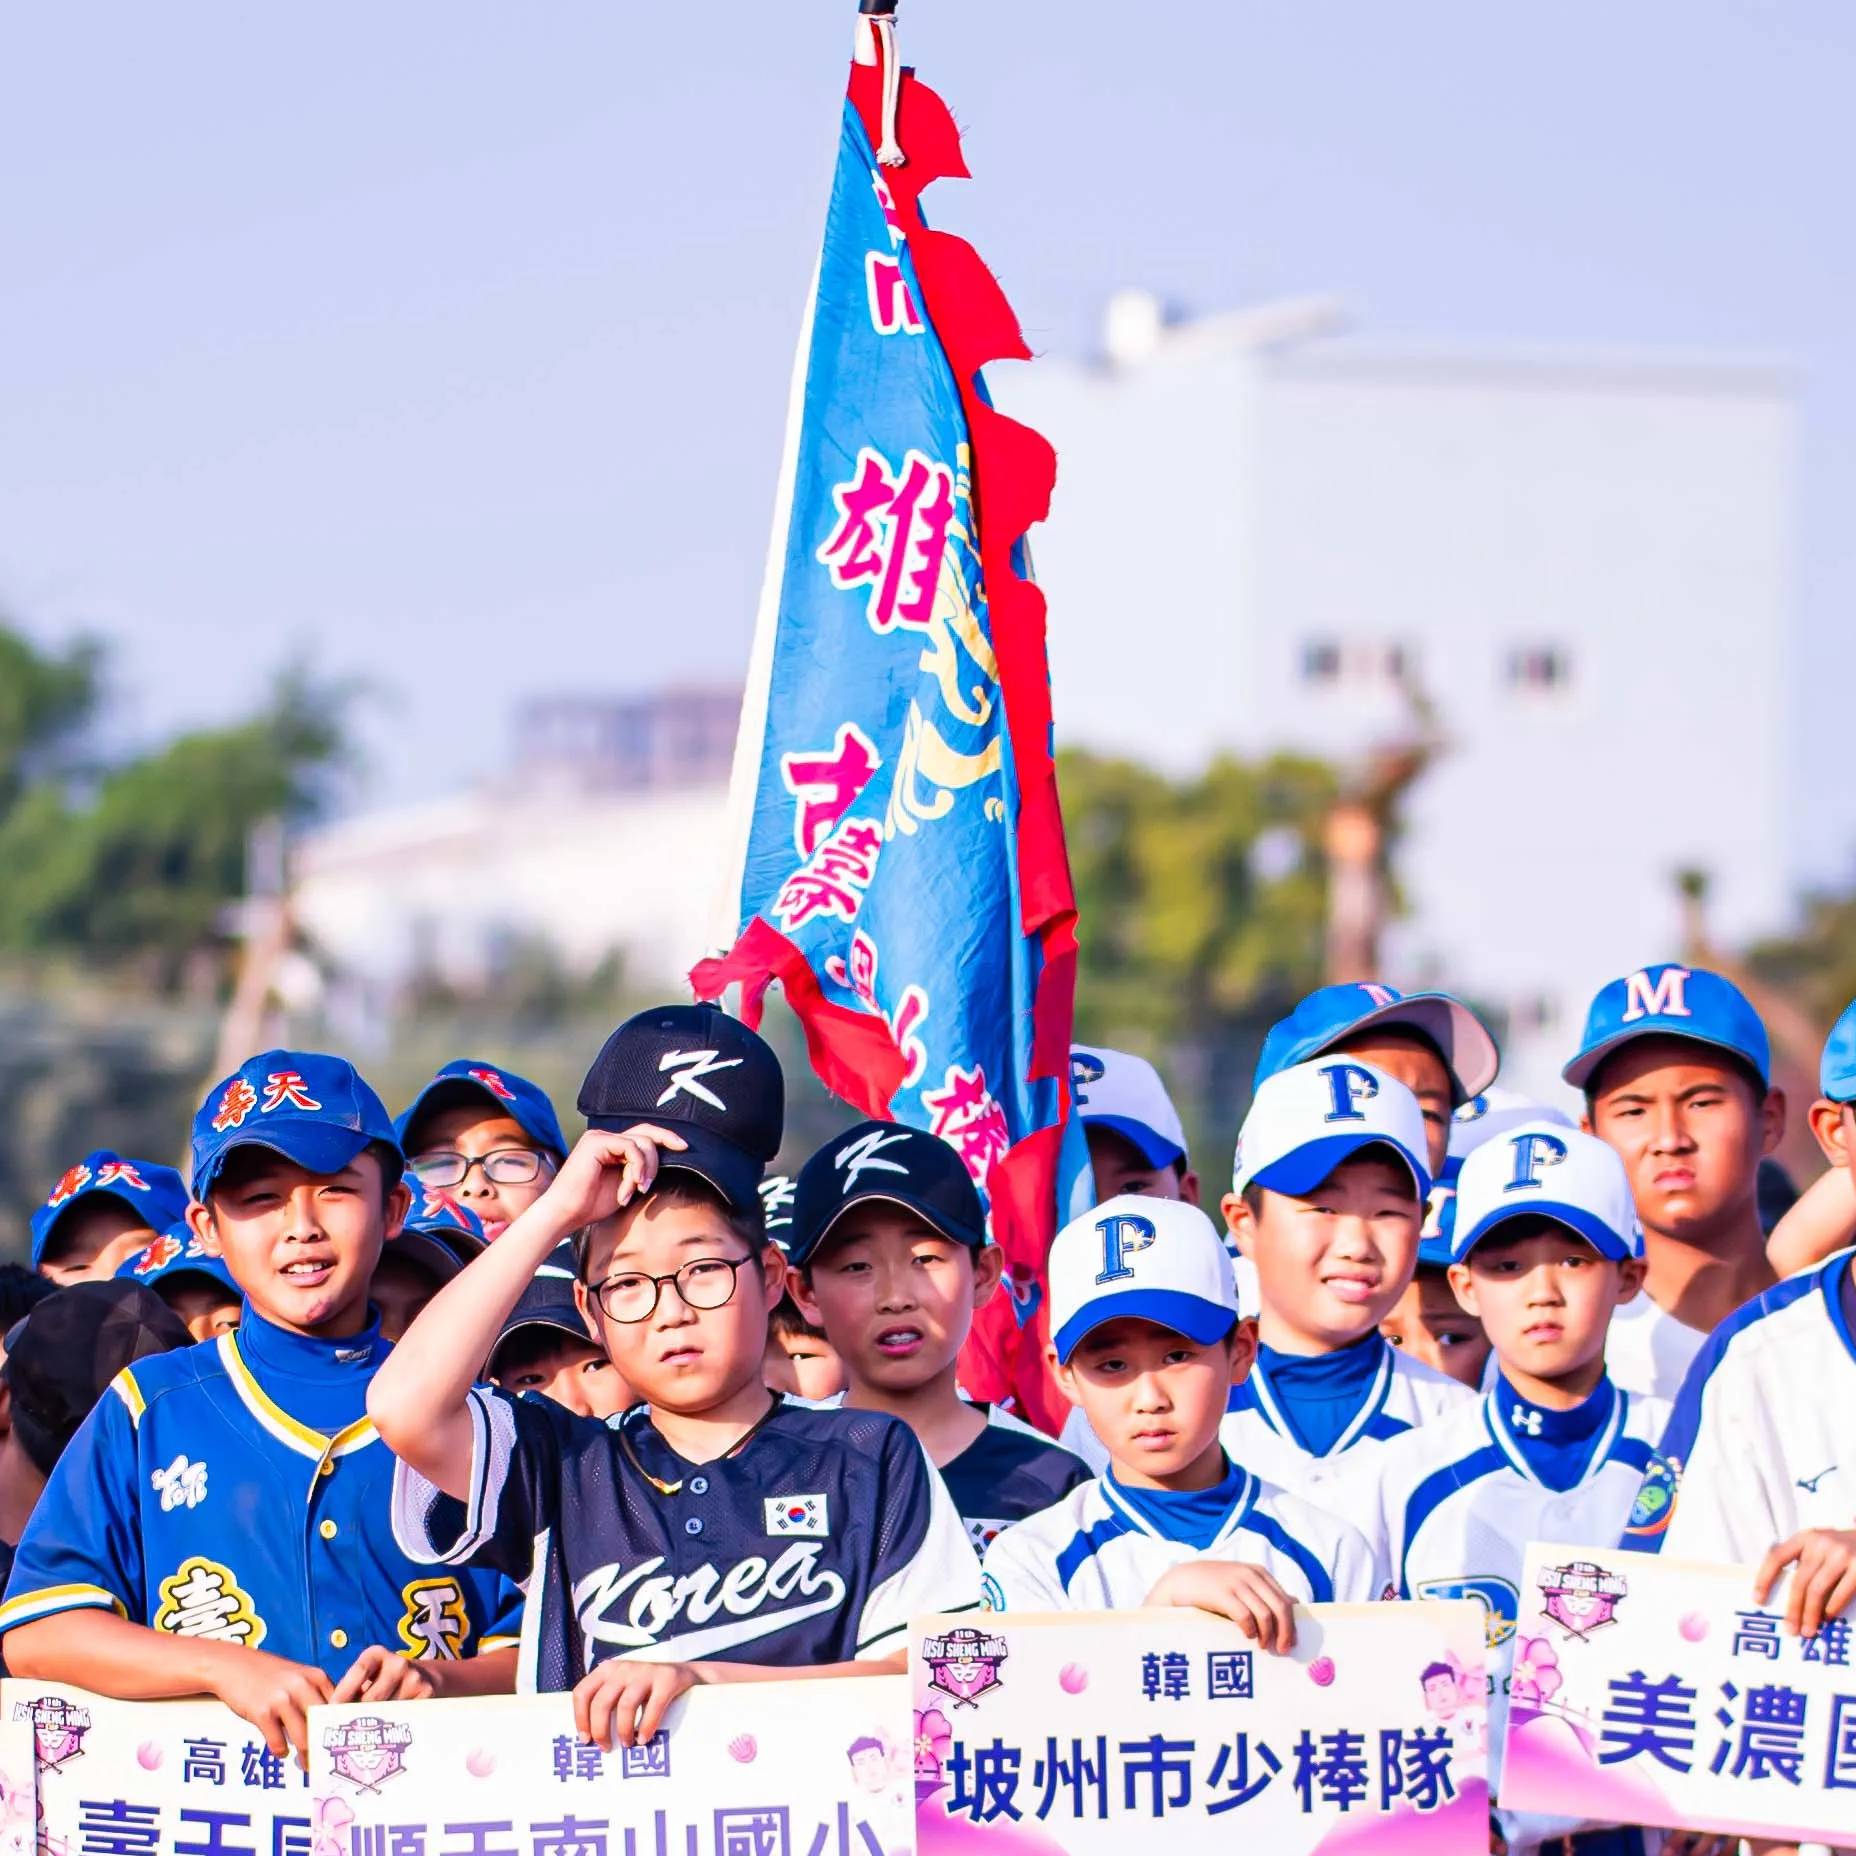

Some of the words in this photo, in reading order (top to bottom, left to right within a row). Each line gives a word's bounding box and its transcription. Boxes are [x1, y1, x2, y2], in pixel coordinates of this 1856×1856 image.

[1621, 968, 1691, 1022] M
[1317, 1063, 1380, 1123] P
[1502, 1133, 1568, 1193] P
[1094, 1213, 1157, 1285] P
[572, 1541, 845, 1655] Korea
[923, 1638, 946, 1658] HSU
[946, 1642, 979, 1658] SHENG
[980, 1637, 1008, 1658] MING
[1142, 1650, 1256, 1702] 韓國
[183, 1736, 311, 1790] 高雄
[551, 1727, 673, 1784] 韓國
[946, 1725, 1457, 1825] 坡州市少棒隊
